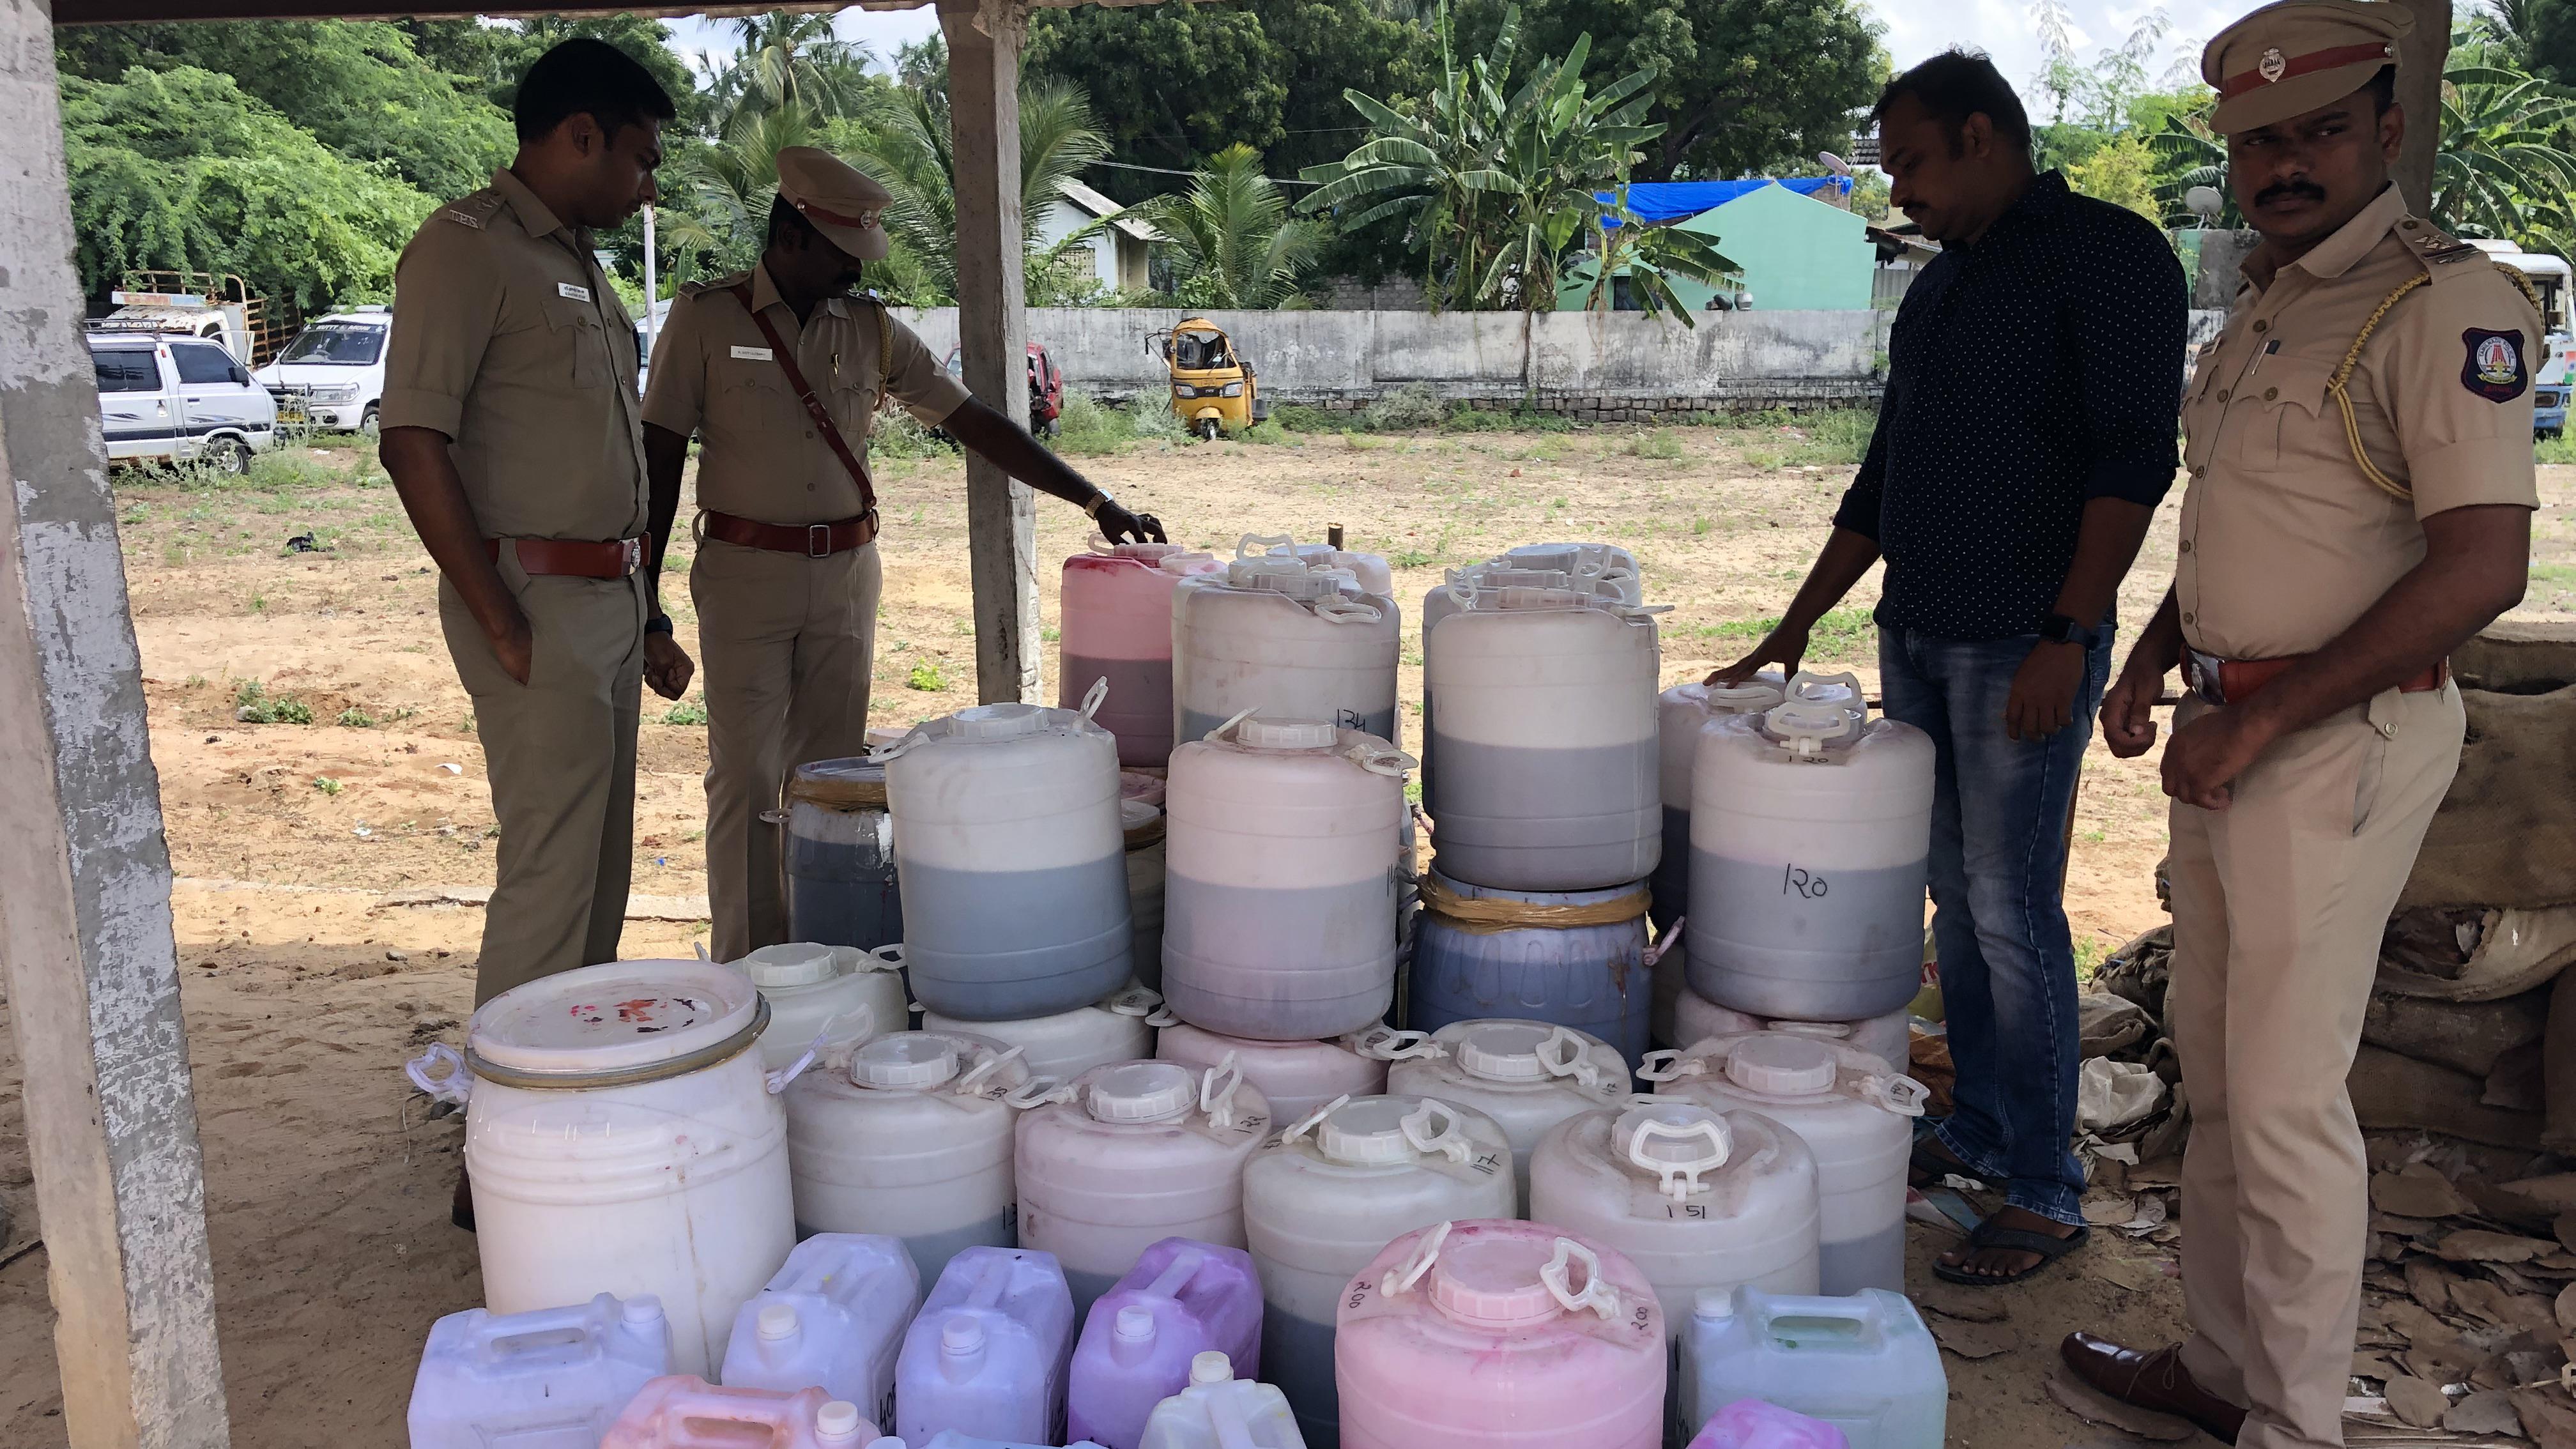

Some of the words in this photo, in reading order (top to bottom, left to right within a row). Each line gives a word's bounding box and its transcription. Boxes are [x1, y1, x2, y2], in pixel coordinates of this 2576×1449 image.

[1337, 709, 1366, 733] 134
[977, 1086, 1008, 1101] 135
[1233, 1116, 1268, 1134] 122
[1469, 1153, 1501, 1176] 117
[1349, 1281, 1372, 1309] 200
[1630, 1307, 1648, 1331] 200
